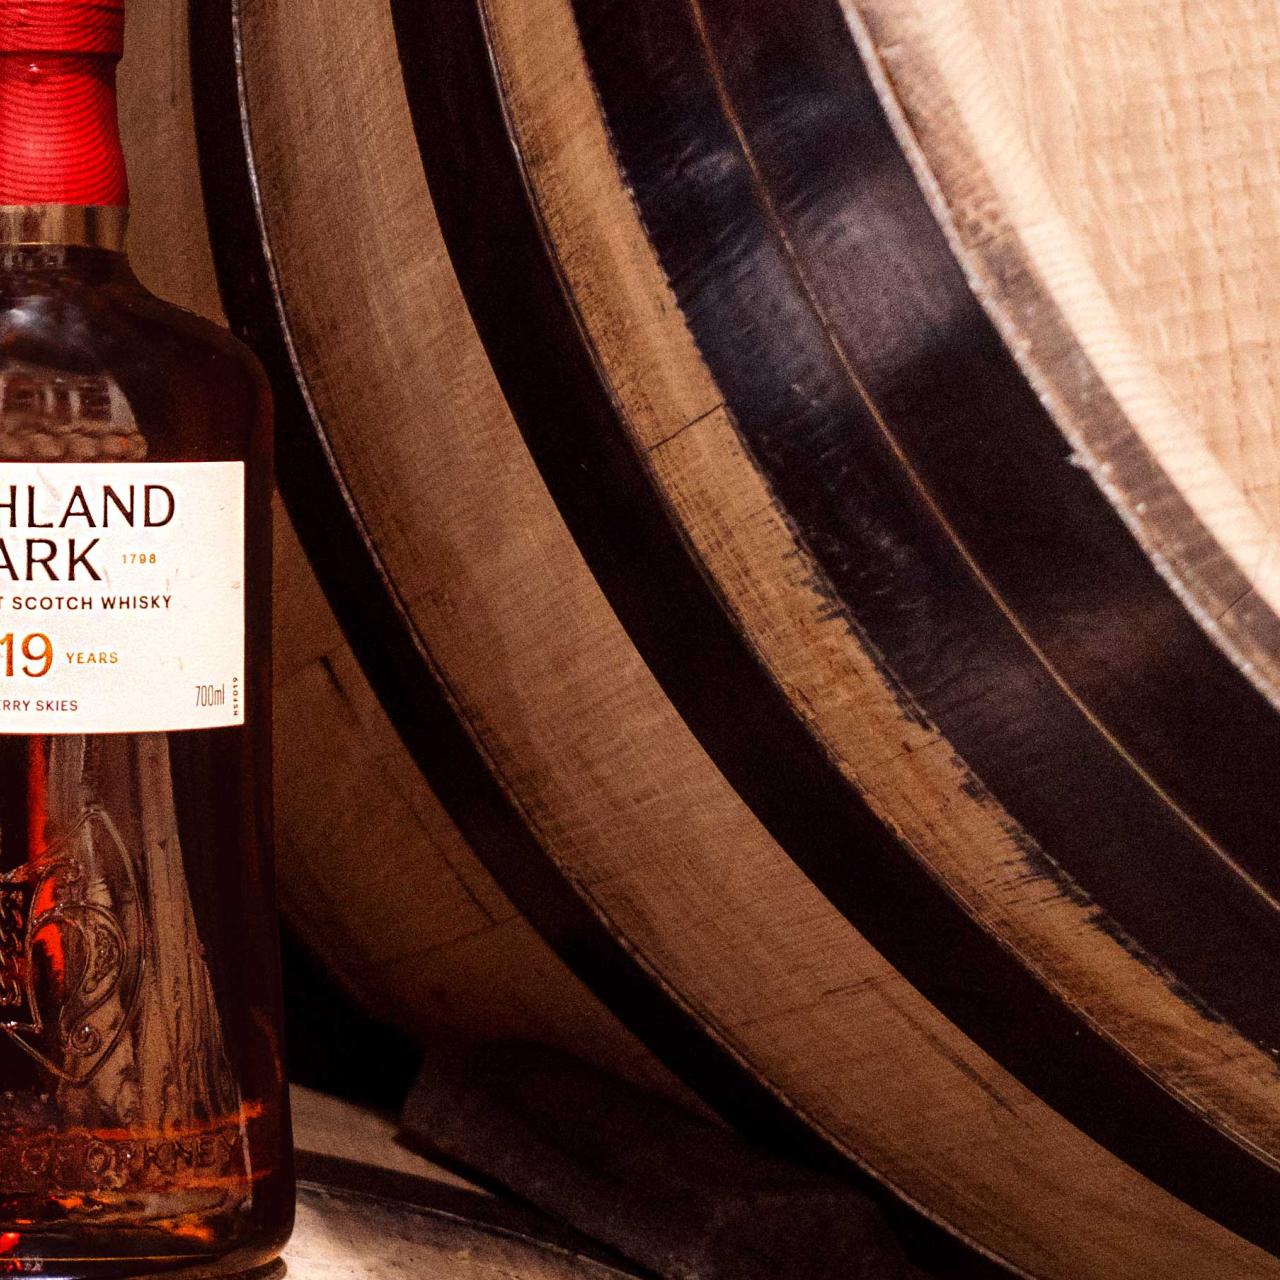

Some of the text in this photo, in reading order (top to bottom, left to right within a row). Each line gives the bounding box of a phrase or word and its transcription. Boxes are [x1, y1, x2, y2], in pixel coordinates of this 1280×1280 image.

[122, 553, 157, 565] 1798
[12, 595, 93, 611] SCOTCH
[102, 594, 173, 610] WHISKY
[66, 651, 119, 665] YEARS
[195, 683, 225, 707] 700ml
[35, 699, 79, 712] SKIES
